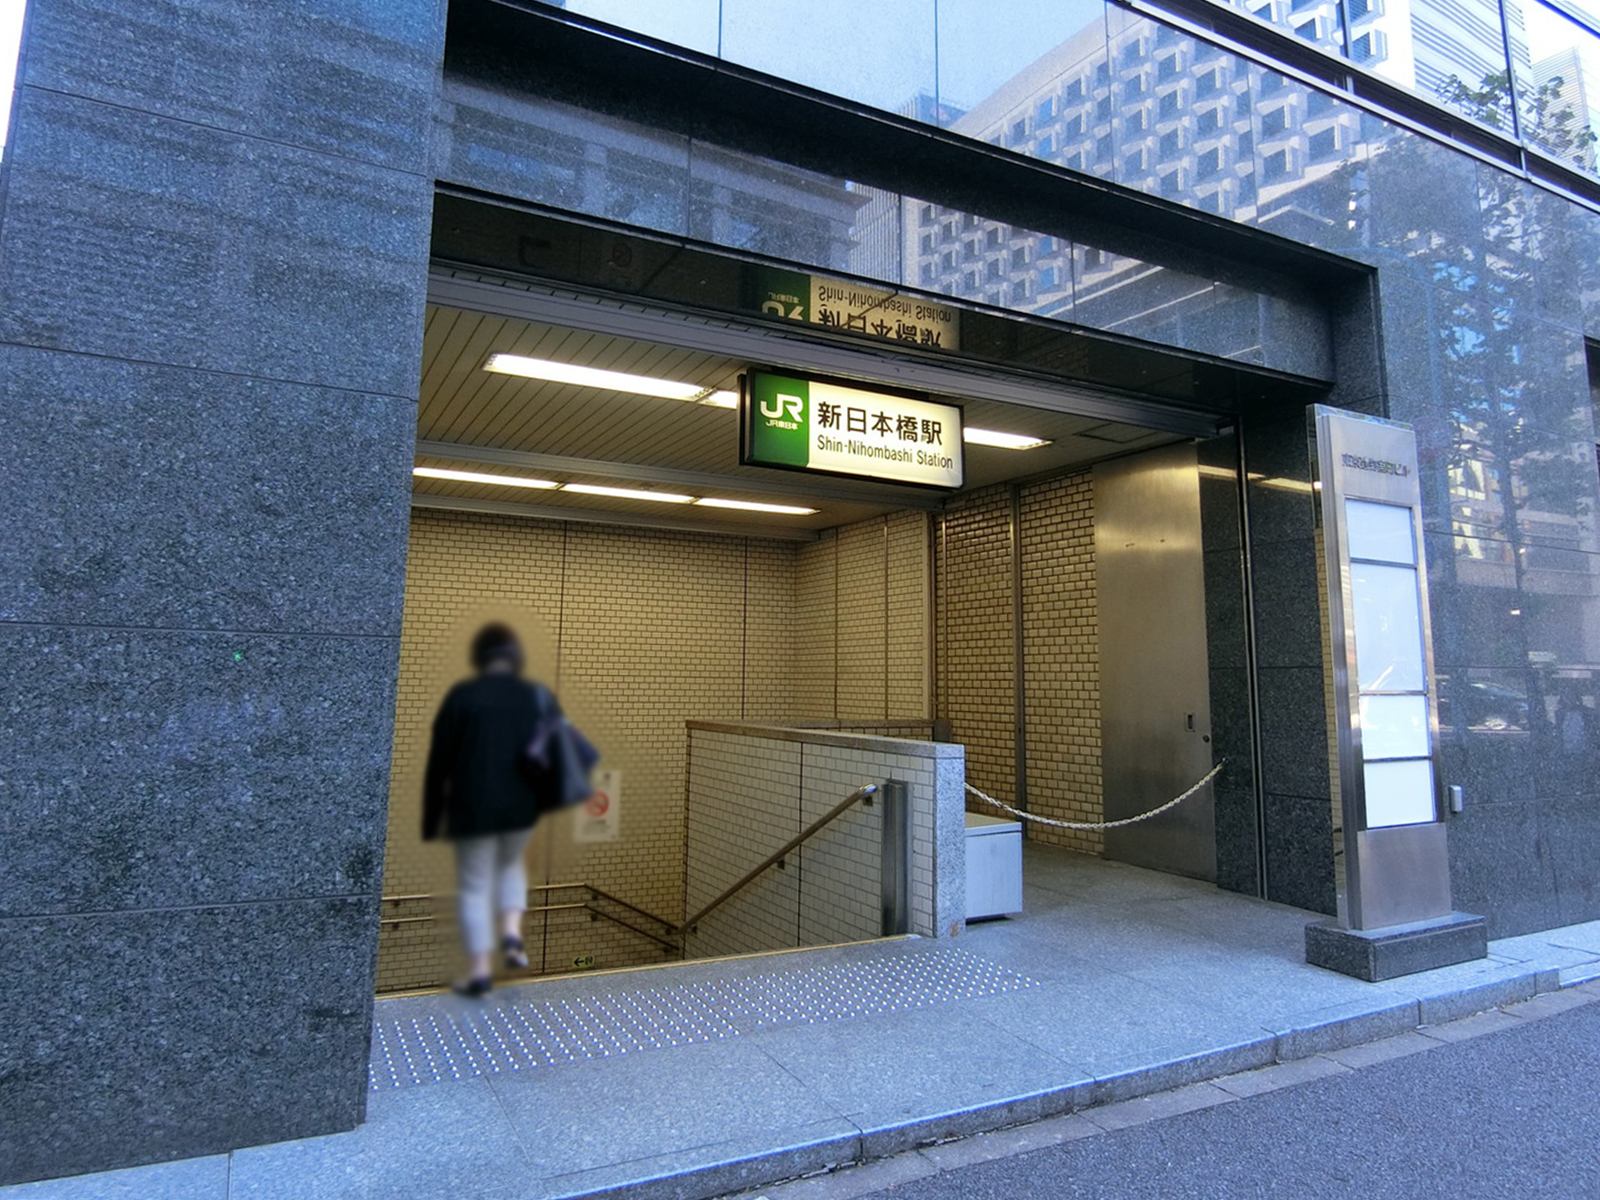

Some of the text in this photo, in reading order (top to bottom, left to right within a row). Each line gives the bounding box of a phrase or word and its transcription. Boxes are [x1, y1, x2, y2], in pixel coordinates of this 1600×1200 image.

[760, 393, 804, 423] JR
[817, 401, 943, 446] 新日本橋駅
[817, 434, 954, 470] Shin-Nihombashi Station
